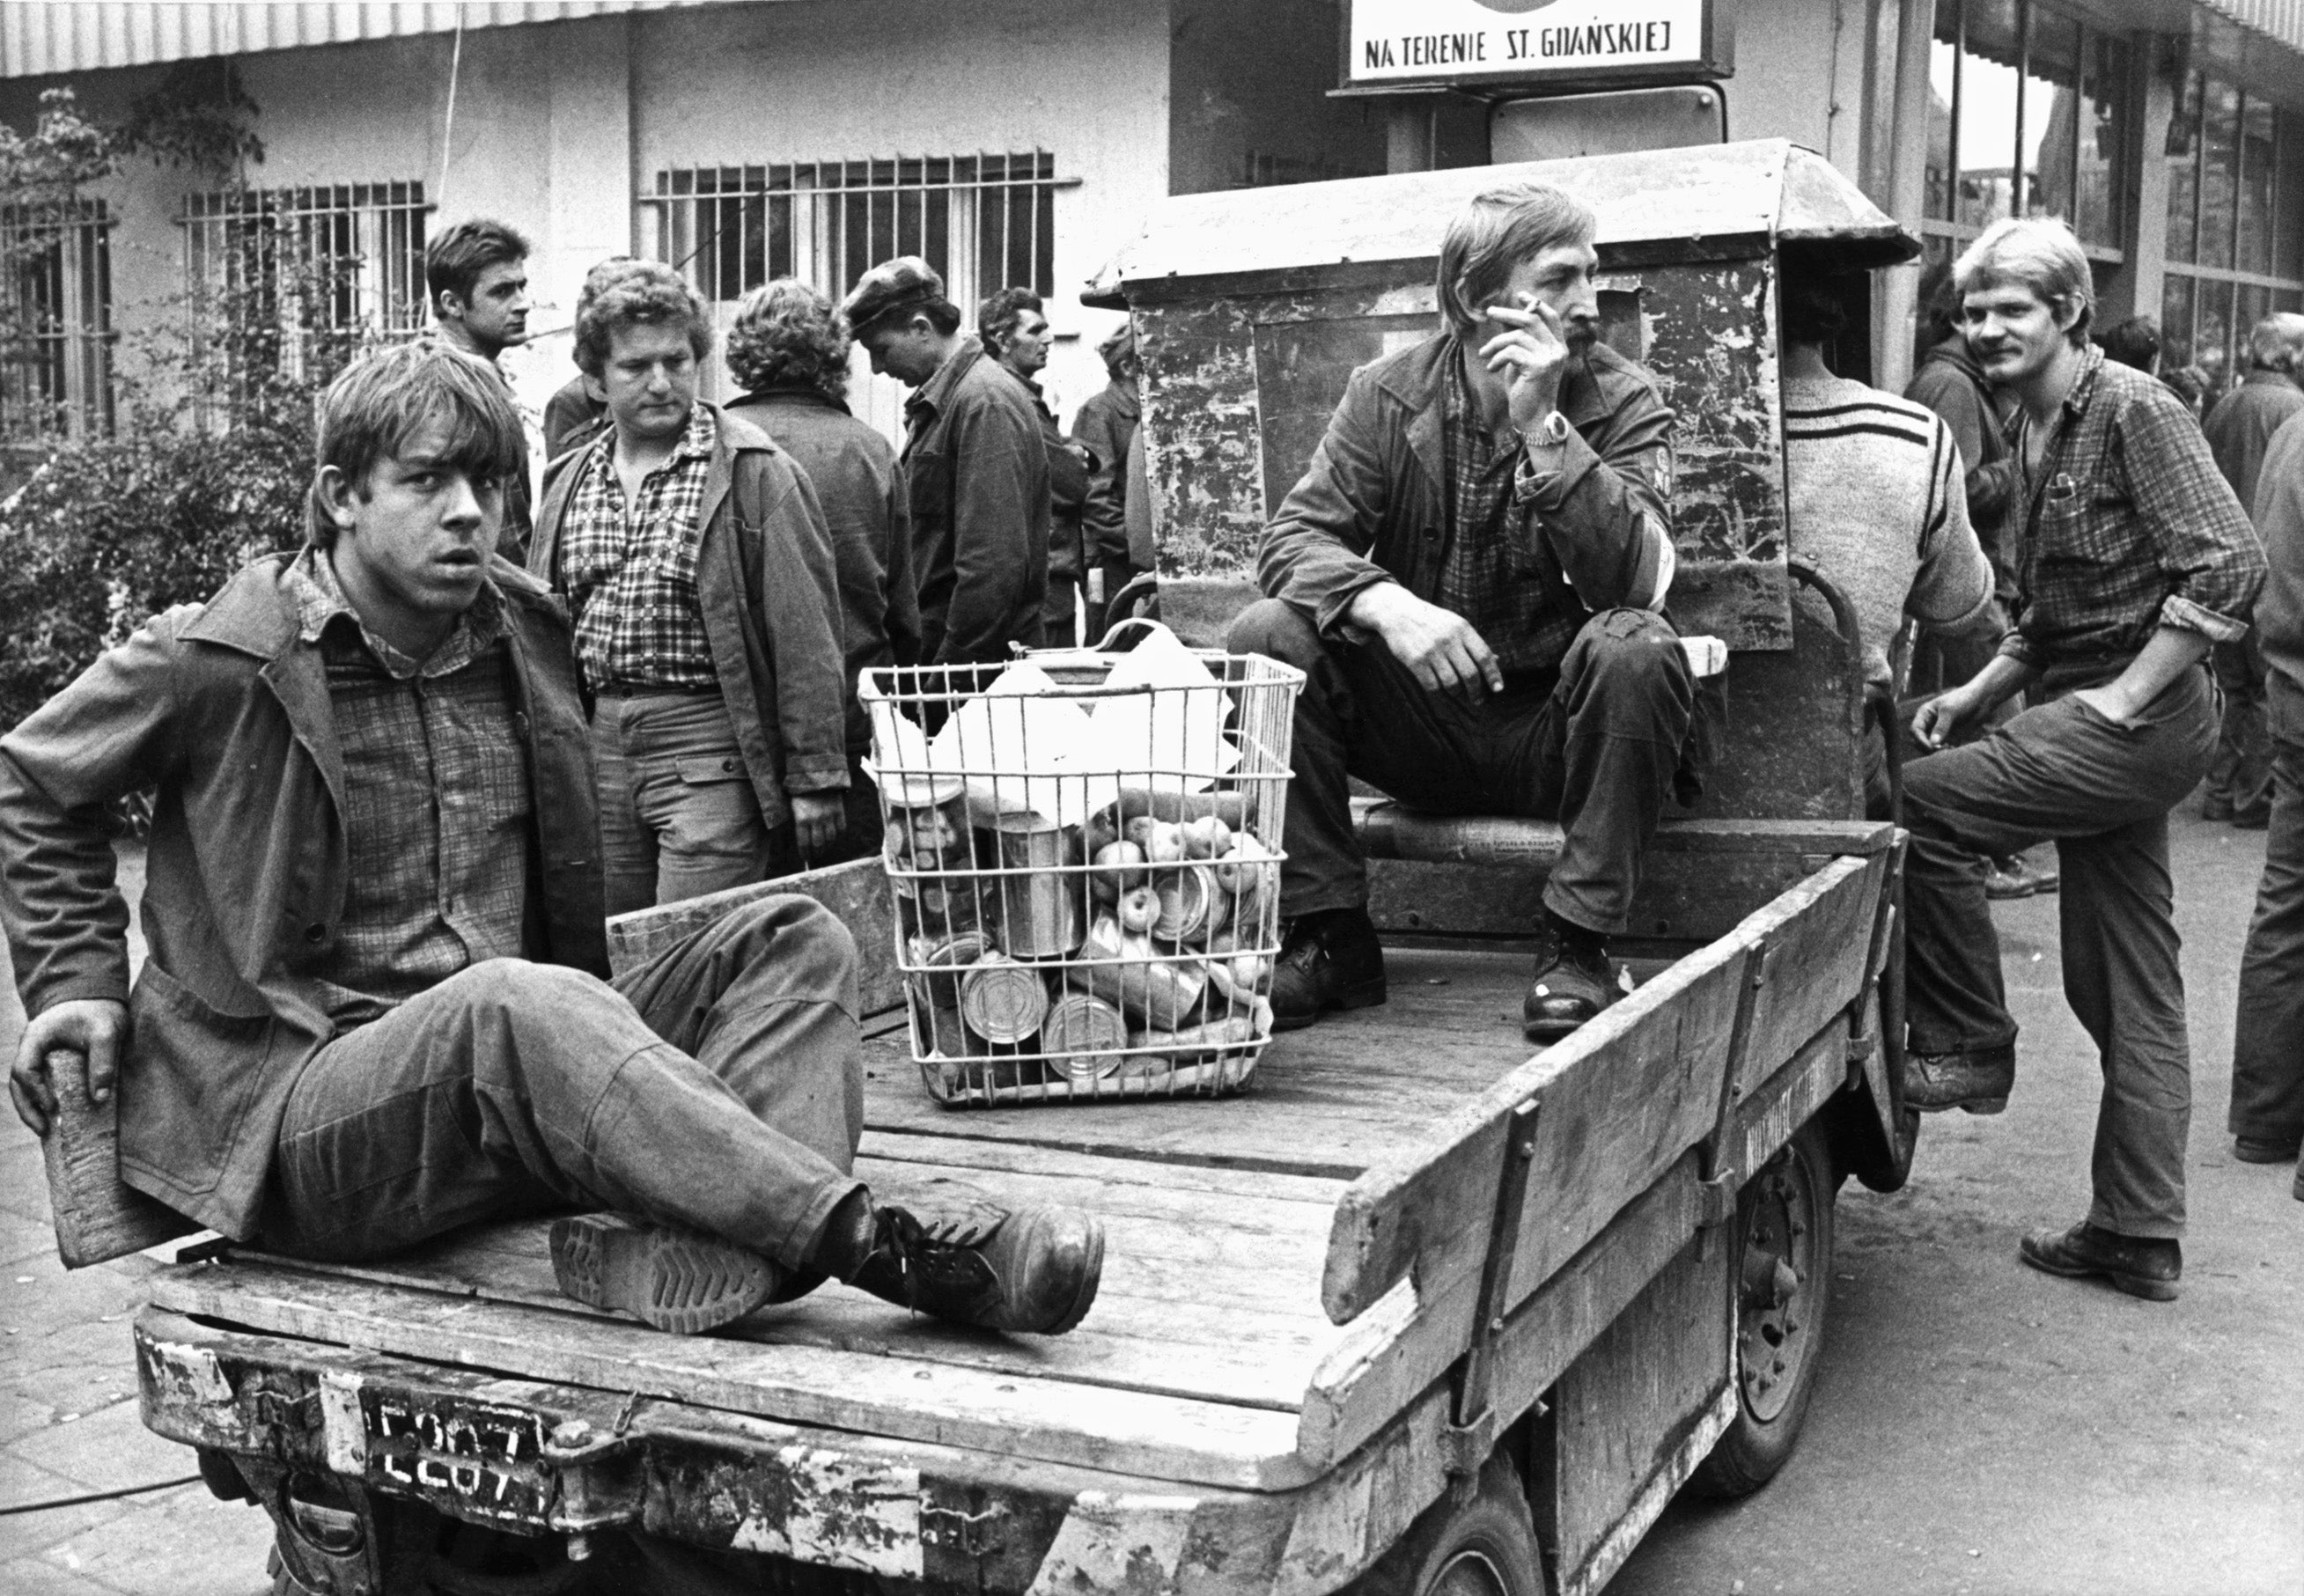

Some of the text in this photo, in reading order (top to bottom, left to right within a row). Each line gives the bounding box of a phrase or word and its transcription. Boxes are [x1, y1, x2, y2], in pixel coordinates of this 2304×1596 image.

[1365, 15, 1671, 69] NA TERENIE ST. GDAŃSKIEJ
